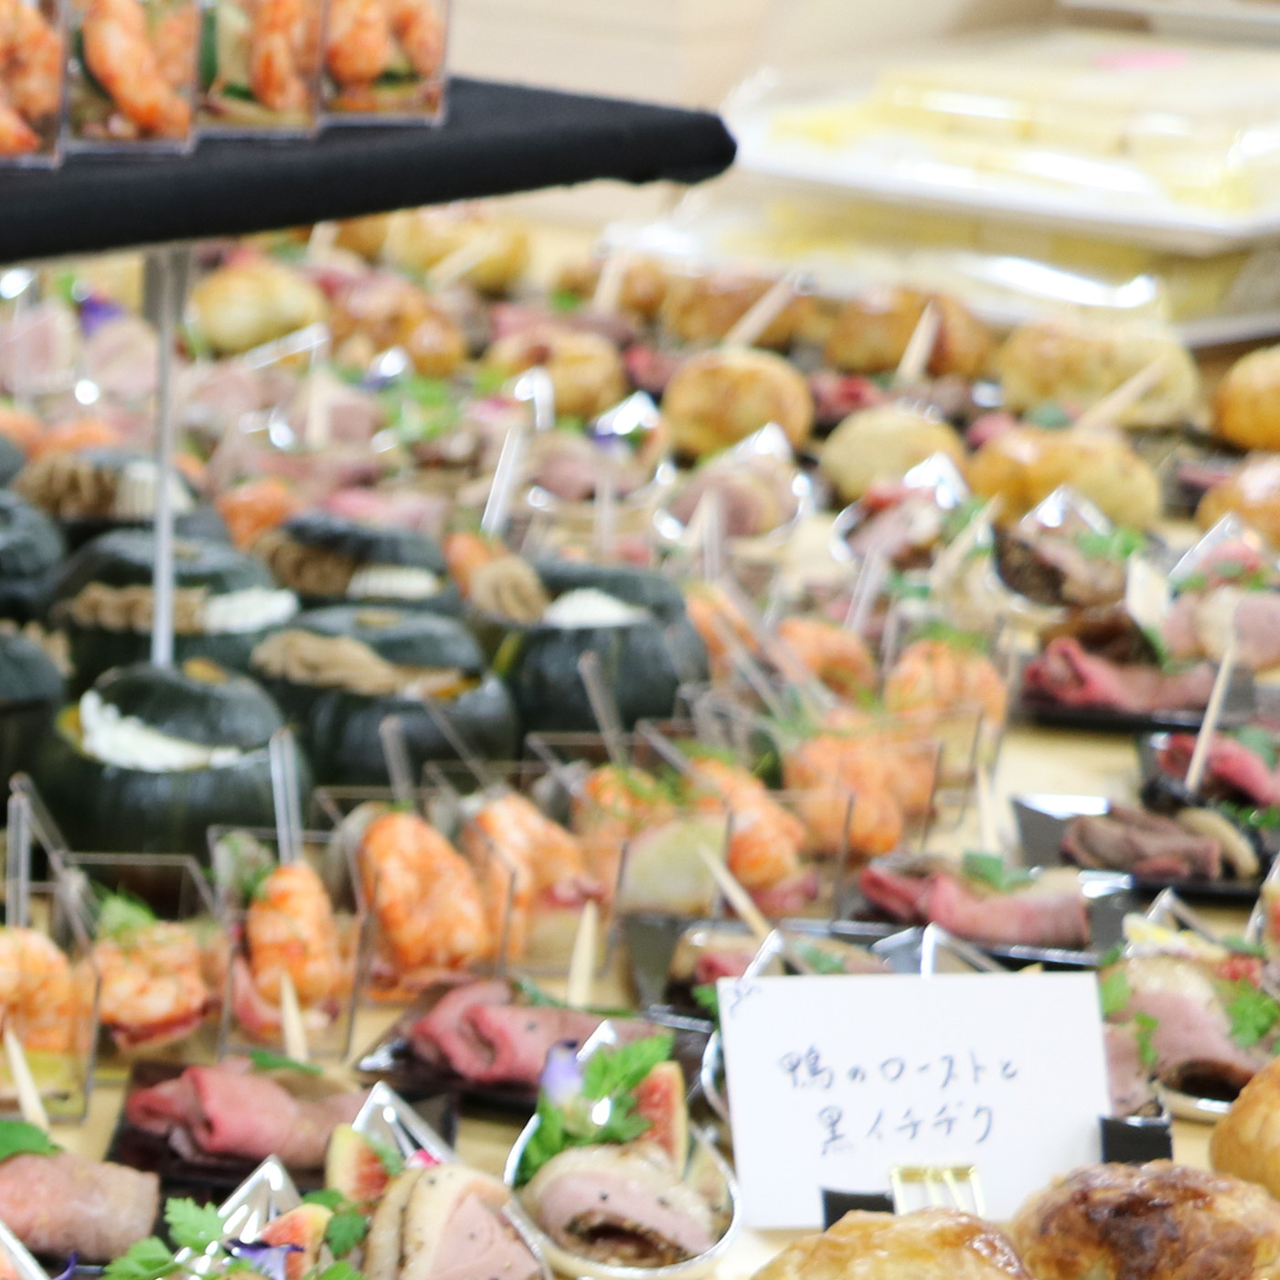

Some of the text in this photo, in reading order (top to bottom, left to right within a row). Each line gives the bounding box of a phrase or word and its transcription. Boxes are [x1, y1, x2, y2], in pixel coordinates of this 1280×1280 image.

[779, 1044, 1020, 1090] 鴨のローストと
